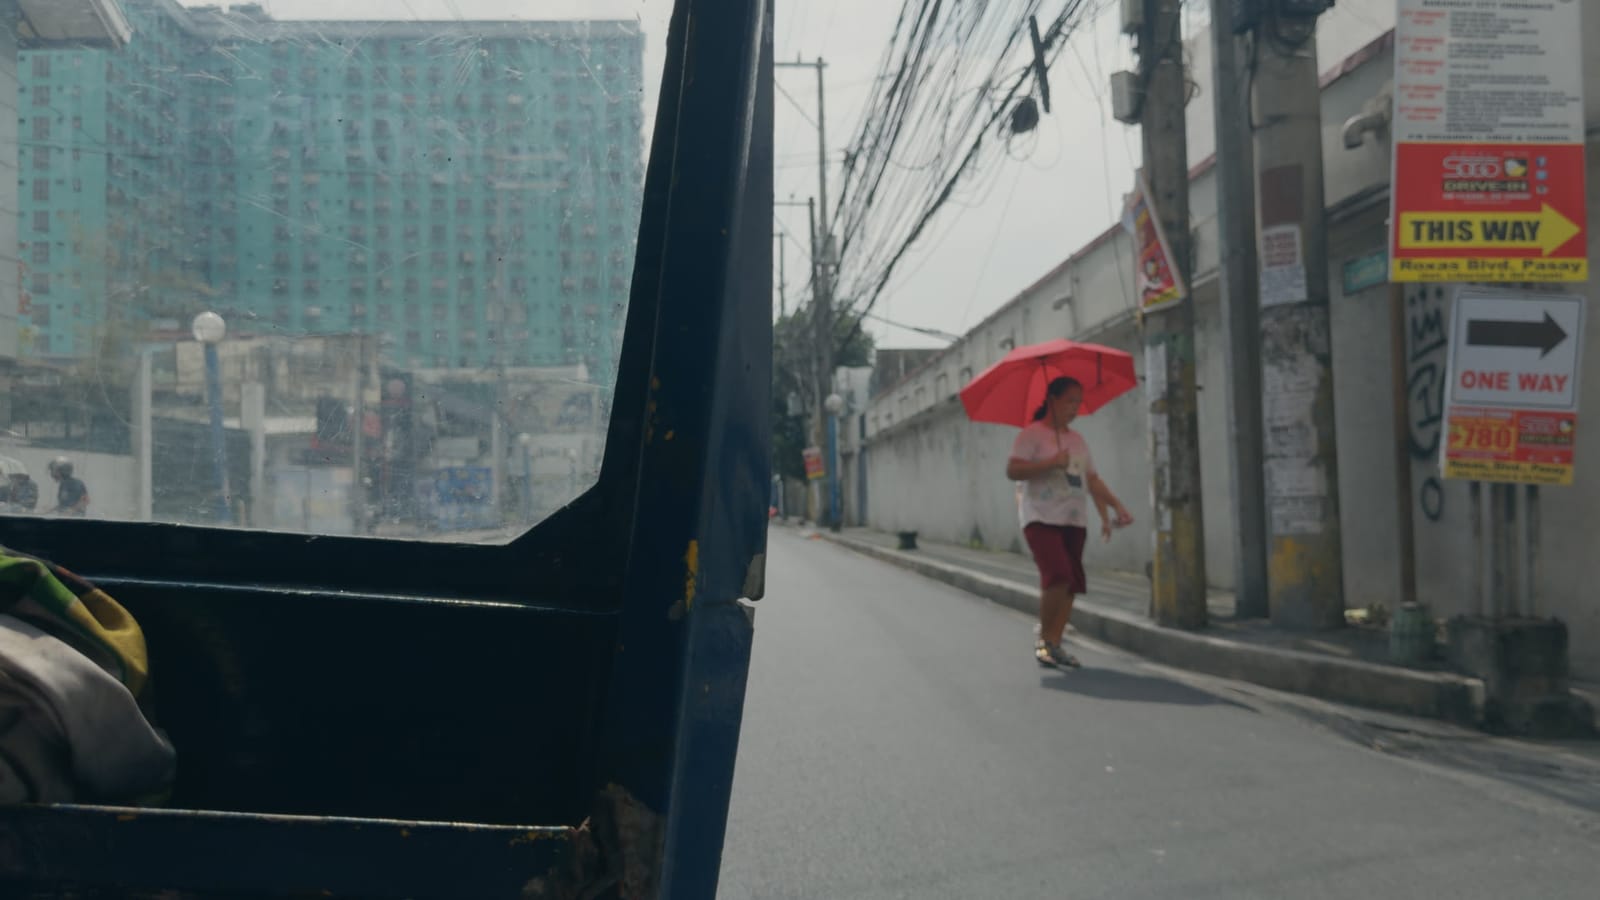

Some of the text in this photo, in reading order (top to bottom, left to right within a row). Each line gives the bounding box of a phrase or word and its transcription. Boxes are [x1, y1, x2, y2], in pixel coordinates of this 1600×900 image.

[1411, 220, 1541, 242] THIS WAY
[1400, 260, 1460, 271] Roxas
[1523, 260, 1582, 273] Pasay
[1460, 370, 1569, 394] ONE WAY
